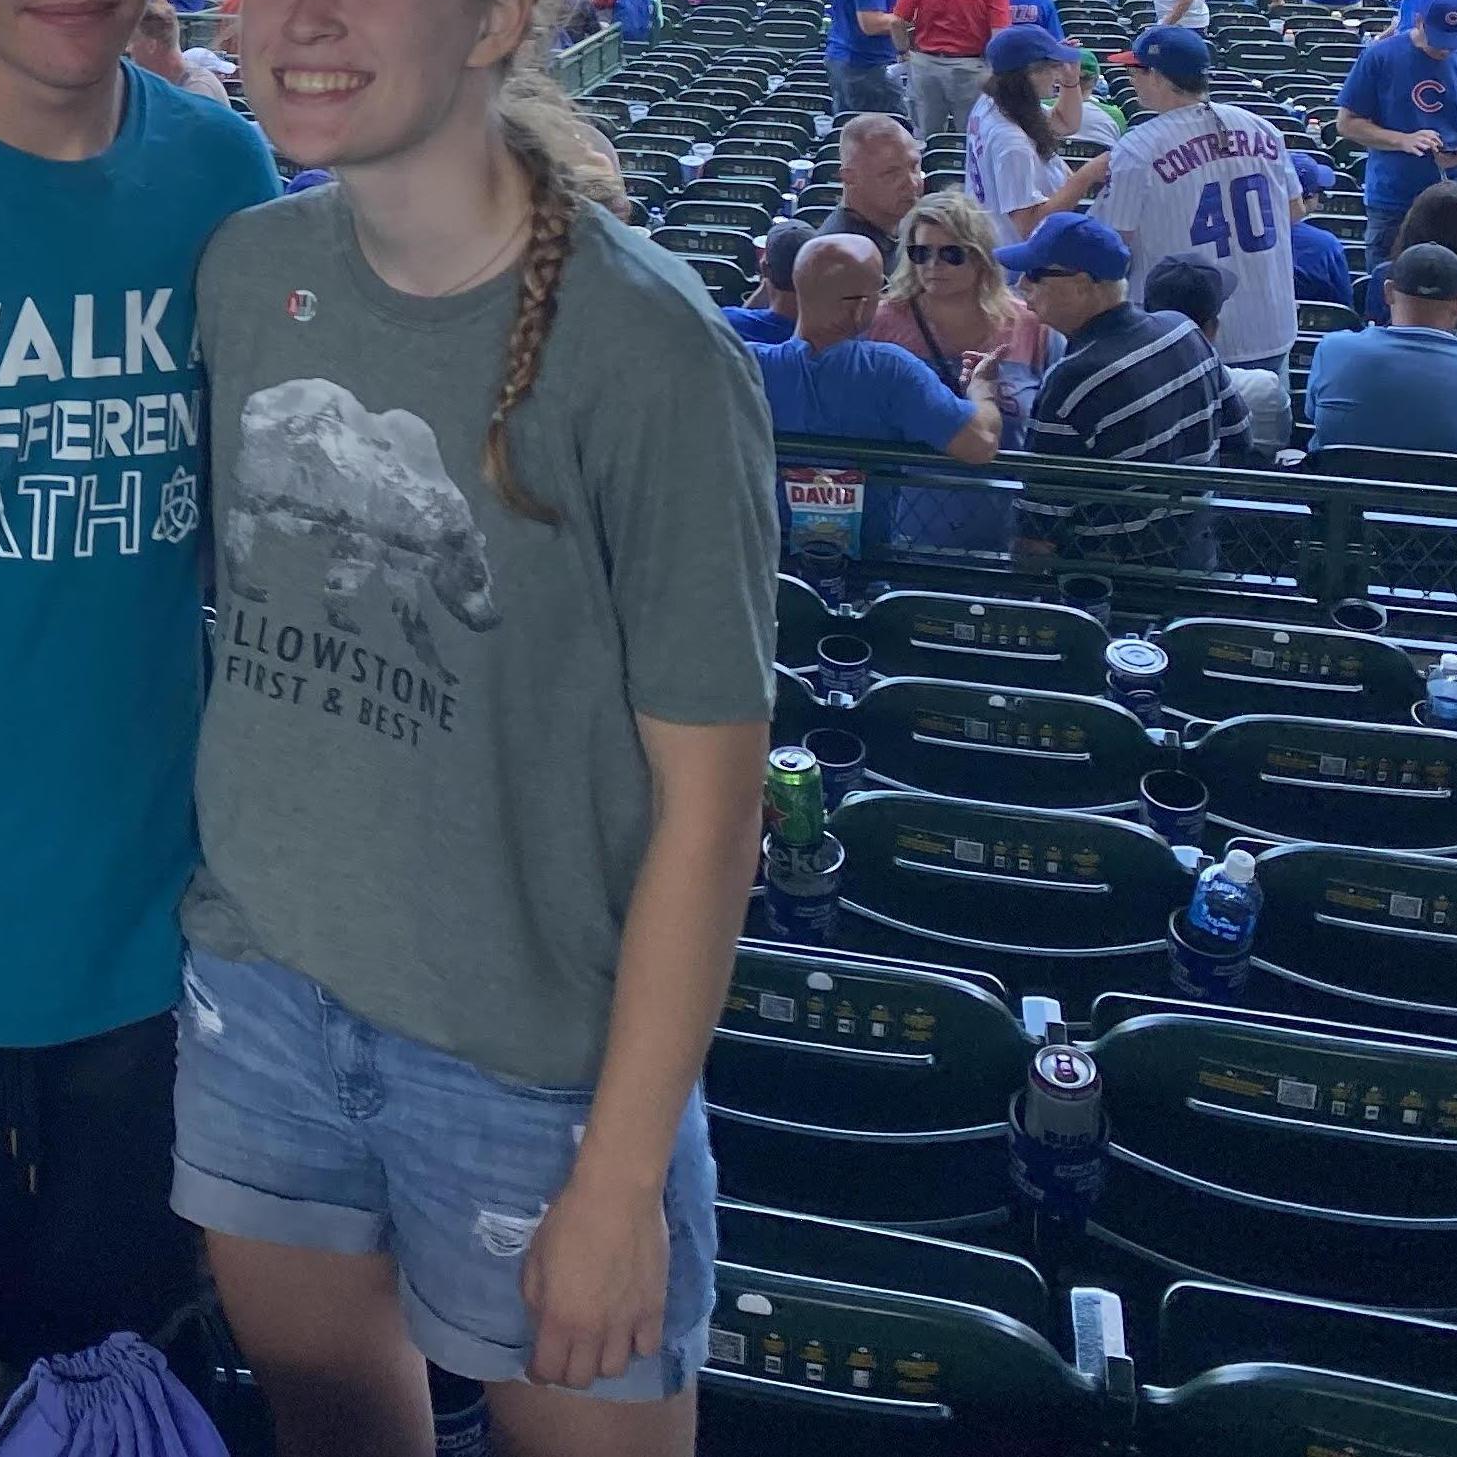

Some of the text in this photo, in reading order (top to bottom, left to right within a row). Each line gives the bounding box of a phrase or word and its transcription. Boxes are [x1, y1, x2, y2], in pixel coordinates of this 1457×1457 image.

[1153, 130, 1279, 184] CONTRERAS
[1190, 173, 1277, 259] 40
[791, 485, 856, 505] DAVID
[226, 606, 456, 734] LLOWSTONE
[226, 655, 422, 748] FIRST & BEST
